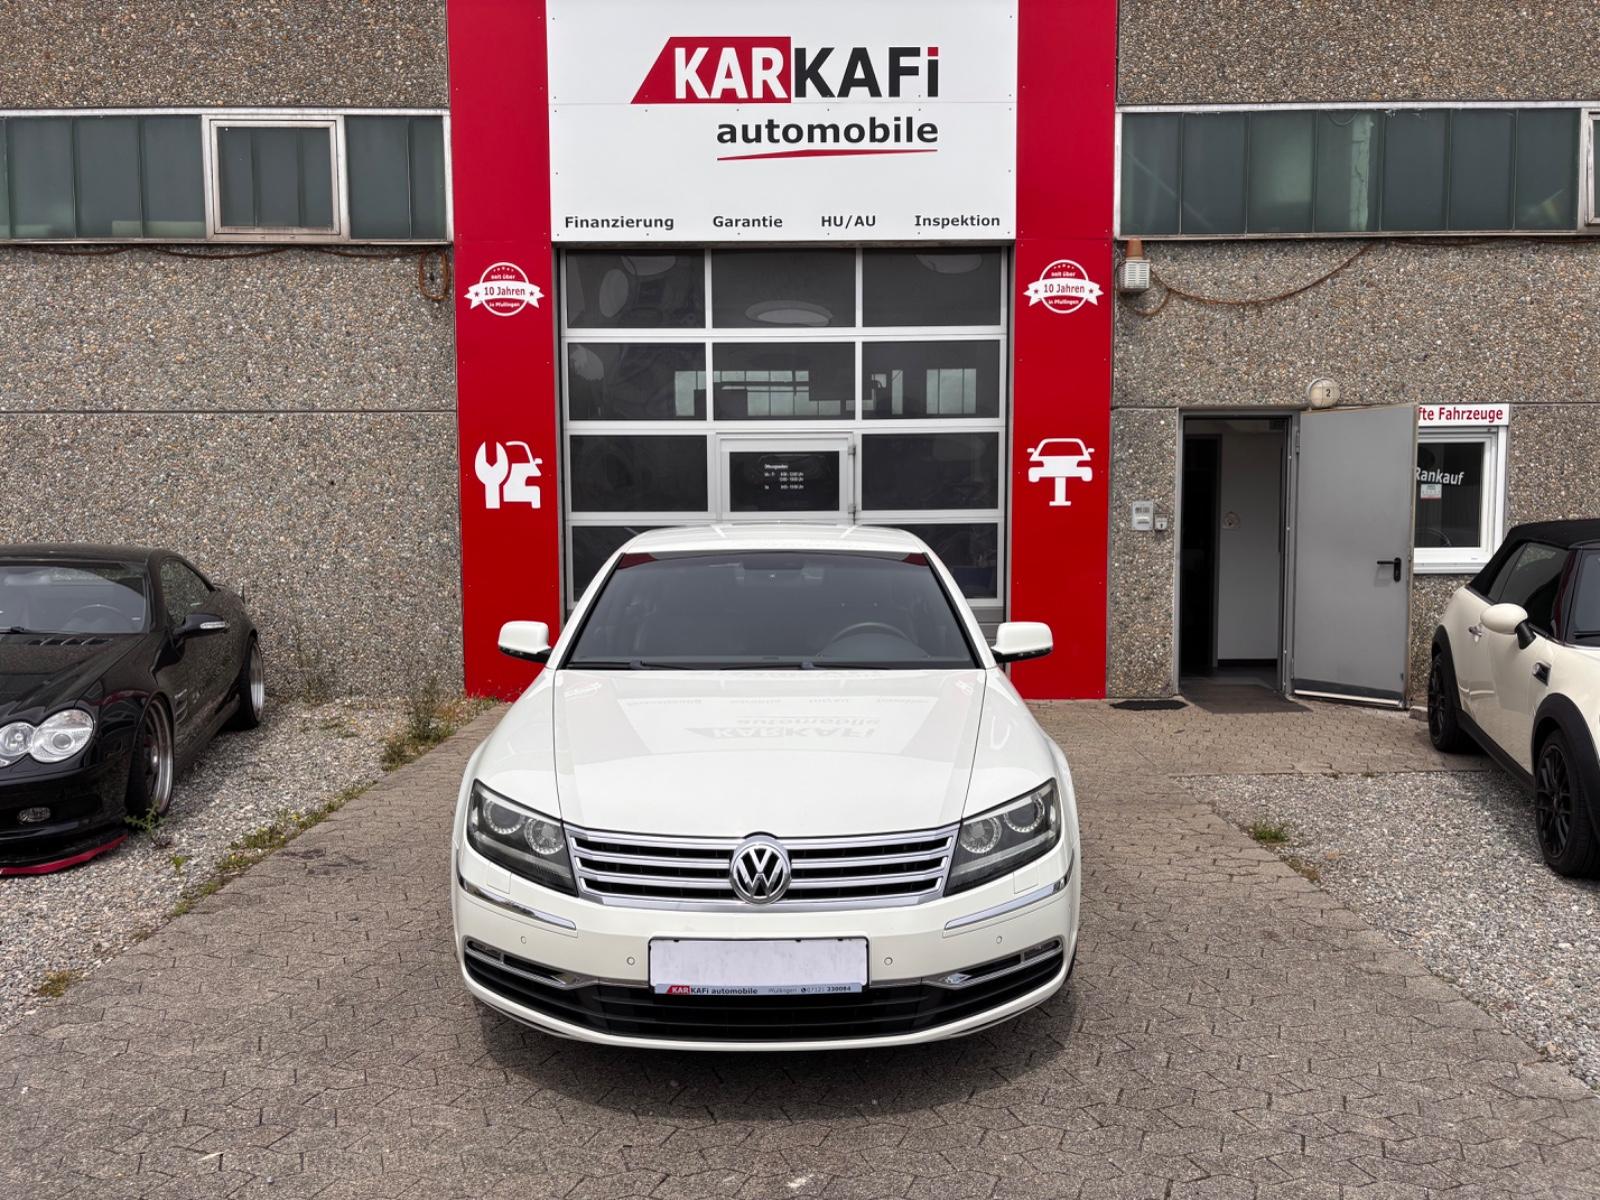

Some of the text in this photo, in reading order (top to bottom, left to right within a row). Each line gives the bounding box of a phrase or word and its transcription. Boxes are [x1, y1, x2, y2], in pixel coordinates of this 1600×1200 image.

[674, 47, 939, 99] KARKAFi
[717, 116, 938, 143] automobile
[564, 215, 1001, 231] Finanzierung Garantie HU/AU Inspektion
[484, 286, 526, 296] 10 Jahren
[1043, 284, 1085, 293] 10 Jahren
[1325, 388, 1331, 398] 2
[1439, 407, 1504, 423] Fahrzeuge
[711, 987, 758, 995] automobile
